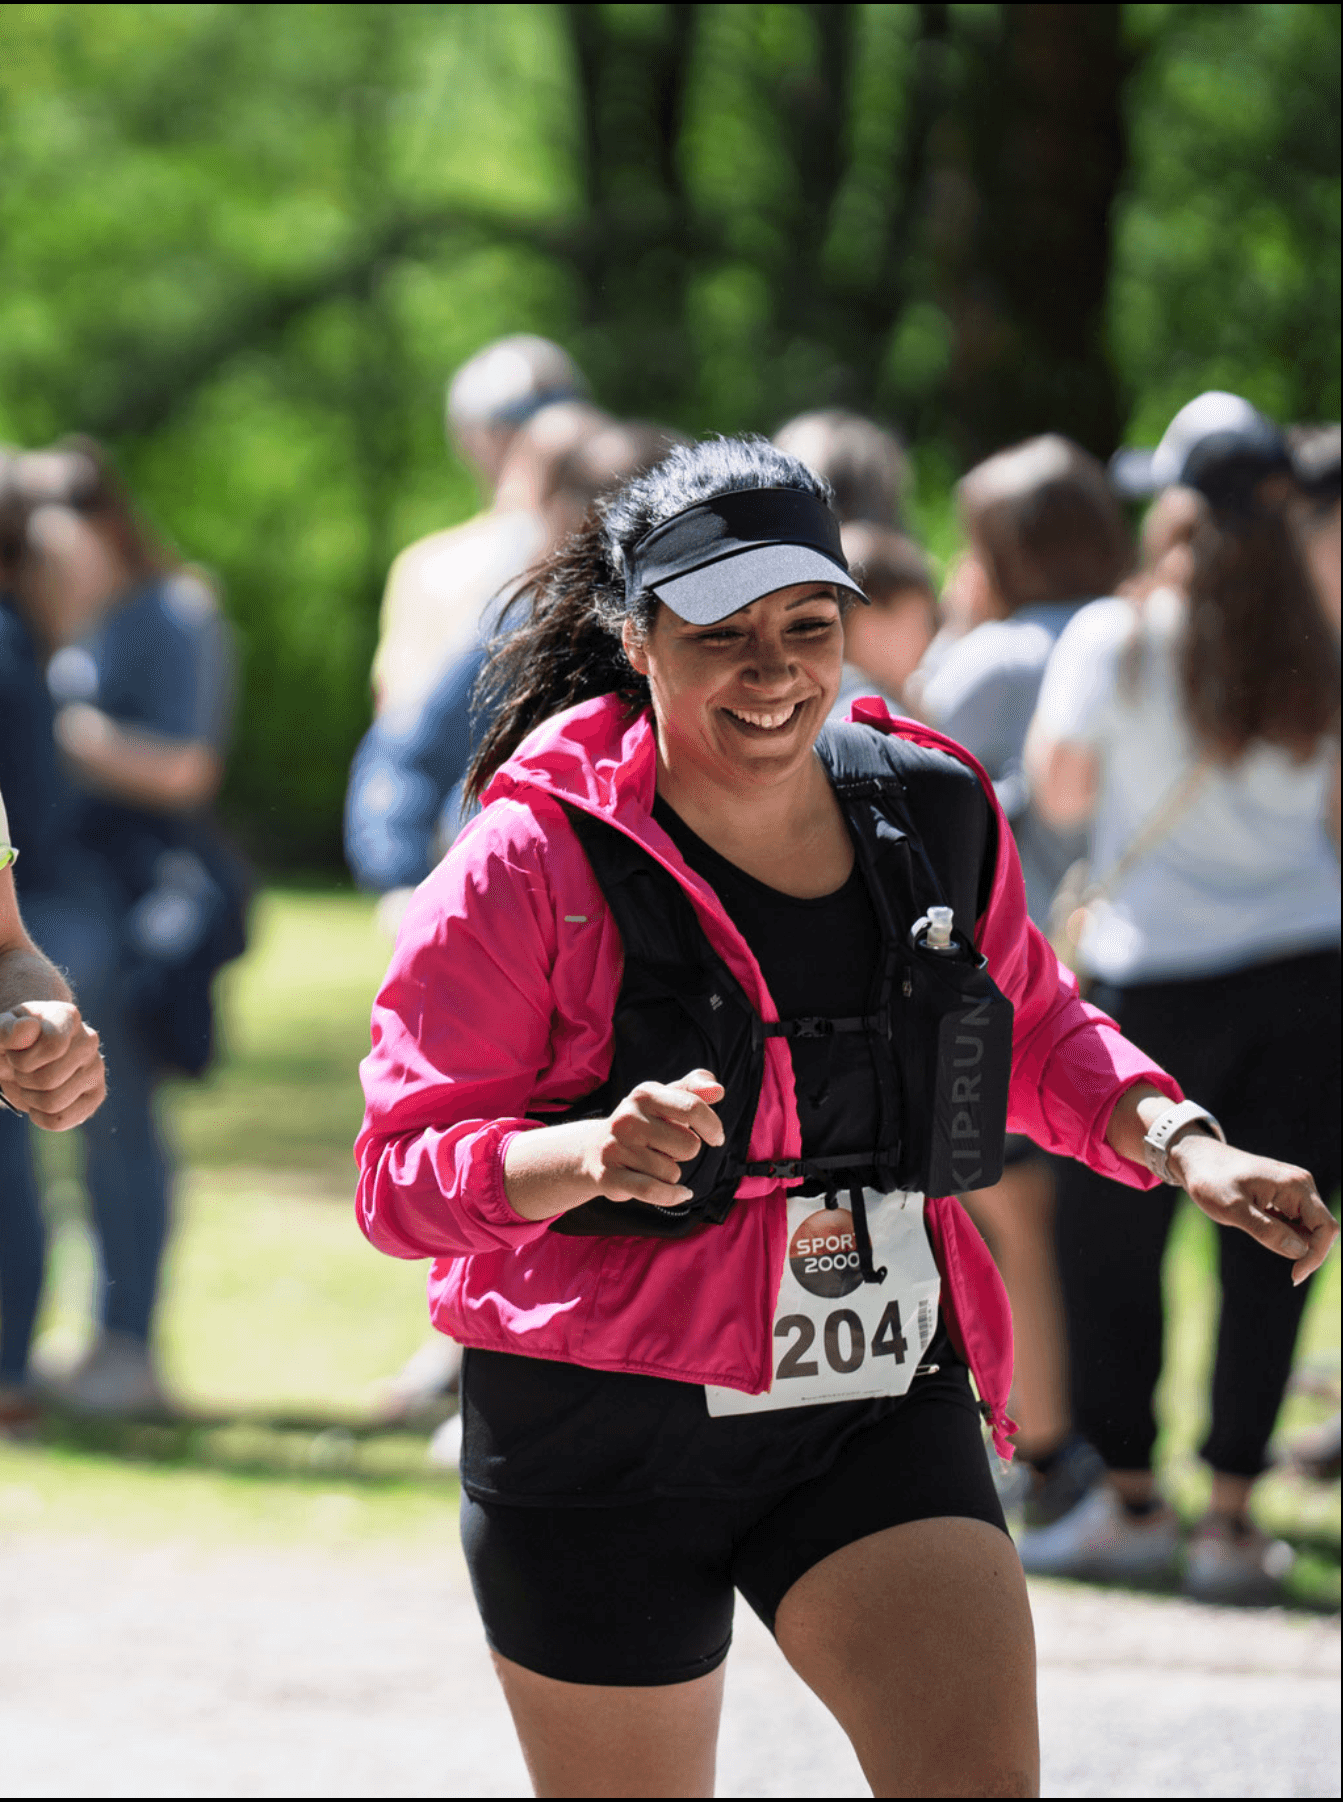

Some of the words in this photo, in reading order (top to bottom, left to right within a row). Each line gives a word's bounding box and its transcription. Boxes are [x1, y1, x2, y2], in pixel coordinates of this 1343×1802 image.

[951, 995, 992, 1194] KIPRUN
[796, 1233, 856, 1255] SPOR
[804, 1251, 860, 1275] 2000
[773, 1300, 909, 1381] 204
